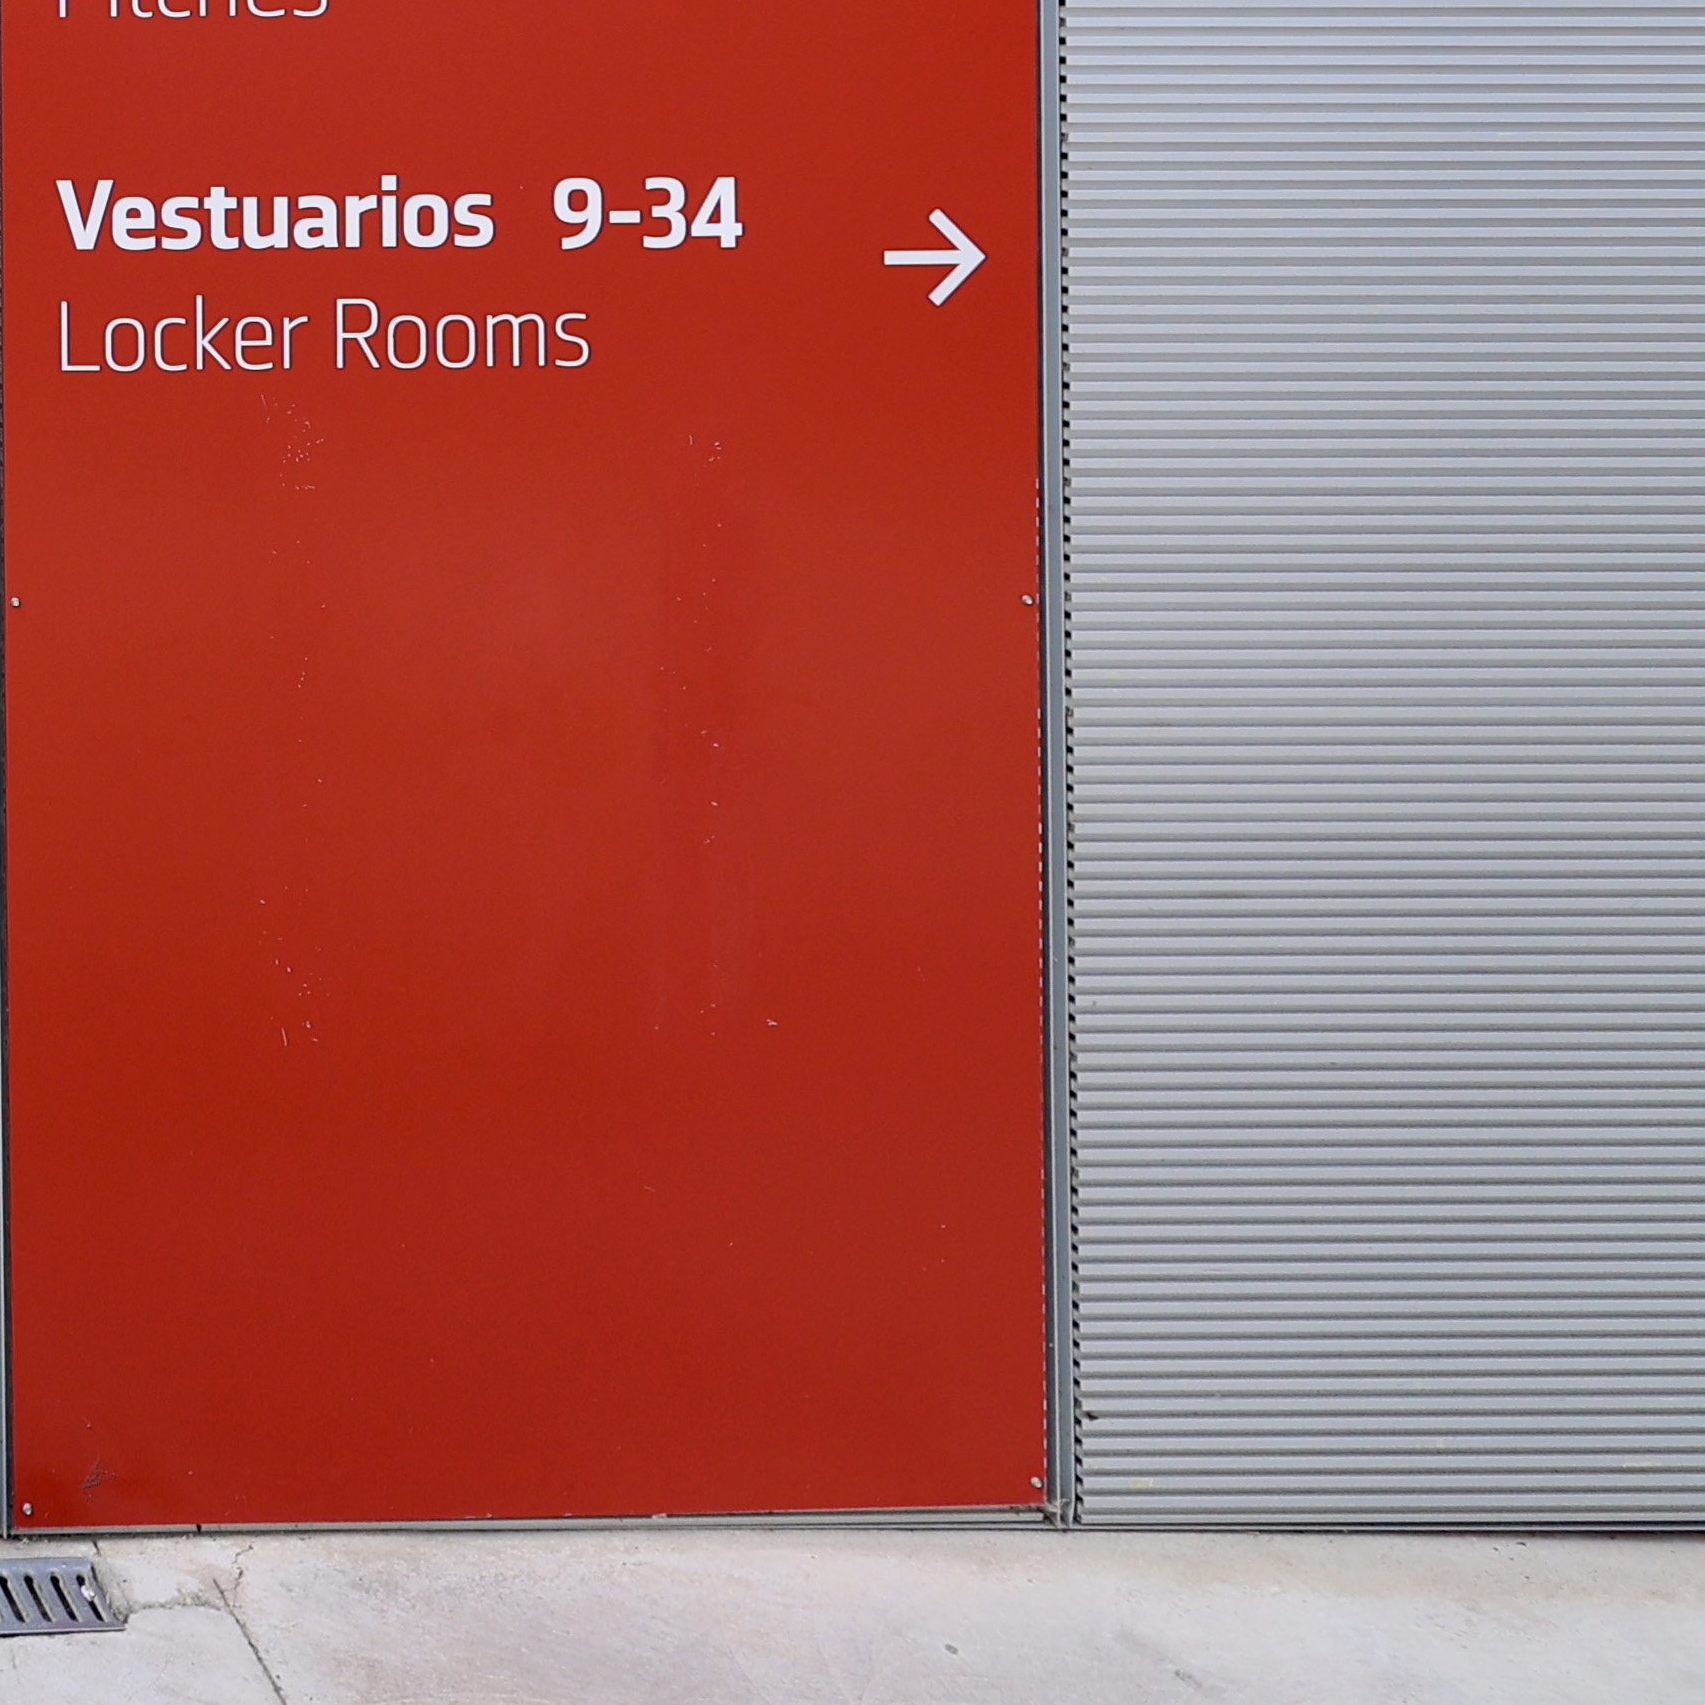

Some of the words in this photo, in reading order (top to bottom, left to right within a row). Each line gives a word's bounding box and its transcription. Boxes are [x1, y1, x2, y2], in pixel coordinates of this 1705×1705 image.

[54, 173, 495, 252] Vestuarios
[552, 176, 744, 250] 9-34
[59, 294, 309, 373] Locker
[335, 297, 590, 370] Rooms
